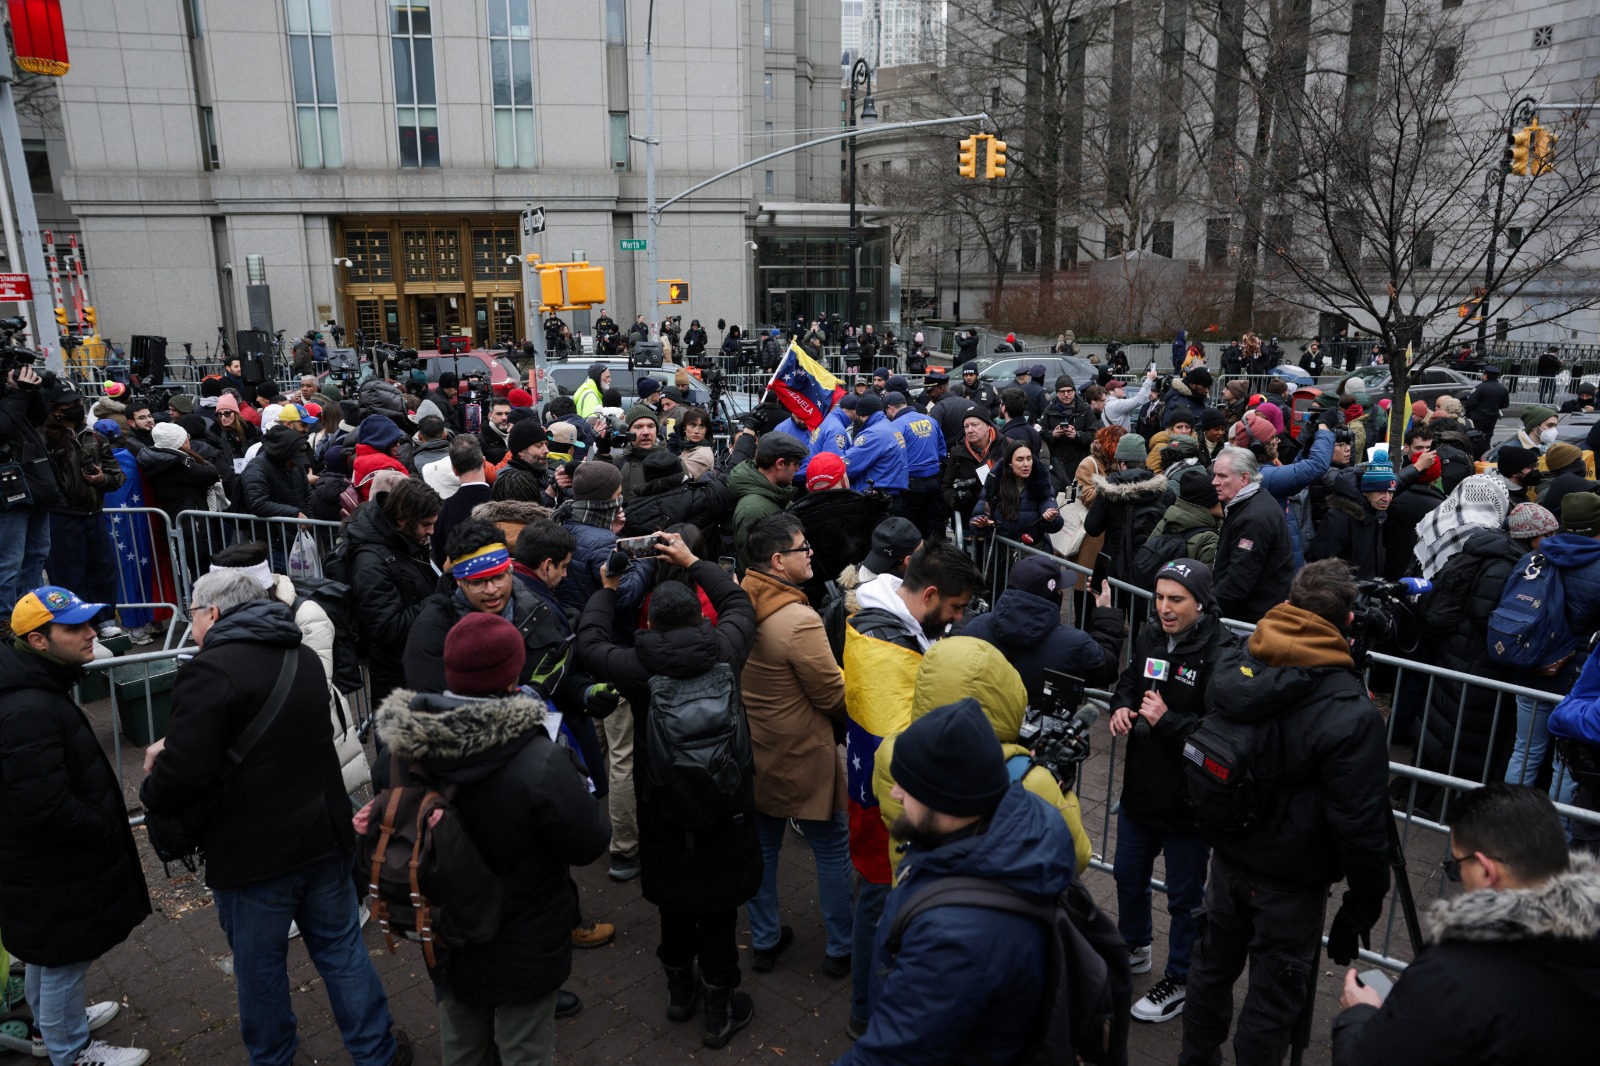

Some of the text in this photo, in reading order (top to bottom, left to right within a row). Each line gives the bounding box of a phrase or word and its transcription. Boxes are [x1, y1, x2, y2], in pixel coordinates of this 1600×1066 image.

[621, 240, 640, 249] Worth
[785, 388, 814, 415] NEZUELA
[909, 419, 933, 433] NYPD
[1174, 674, 1195, 687] NOTICIAS
[1185, 669, 1197, 681] 41
[1205, 757, 1229, 780] PRESS
